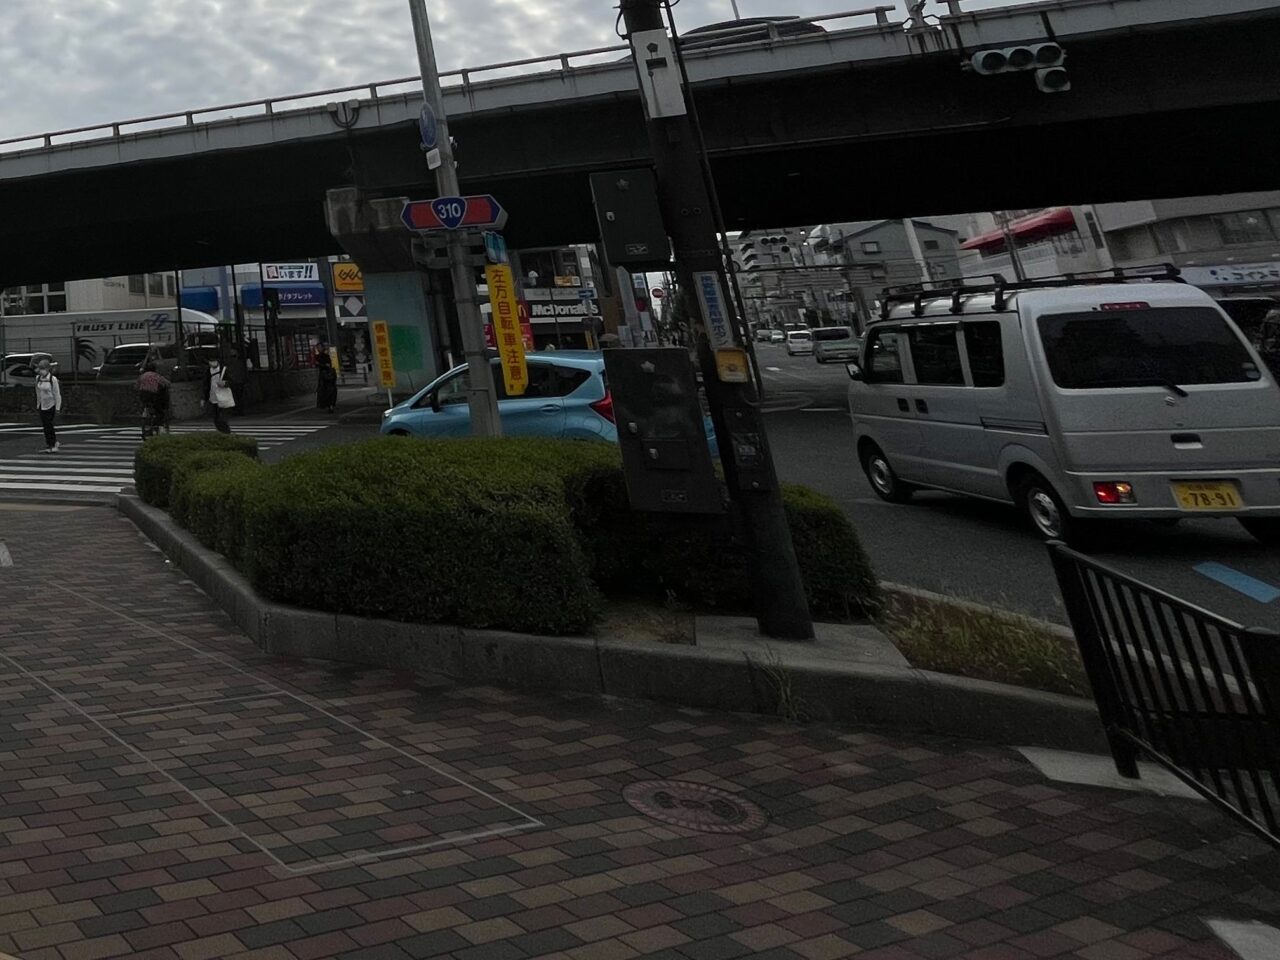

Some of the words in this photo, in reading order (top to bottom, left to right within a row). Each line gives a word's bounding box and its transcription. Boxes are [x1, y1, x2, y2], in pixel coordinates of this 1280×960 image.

[437, 203, 461, 219] 310
[531, 303, 598, 316] McDonals
[76, 323, 114, 332] TRUST
[118, 321, 145, 330] LINE
[491, 269, 522, 381] 左方自転車注意
[1189, 492, 1236, 506] 78-91
